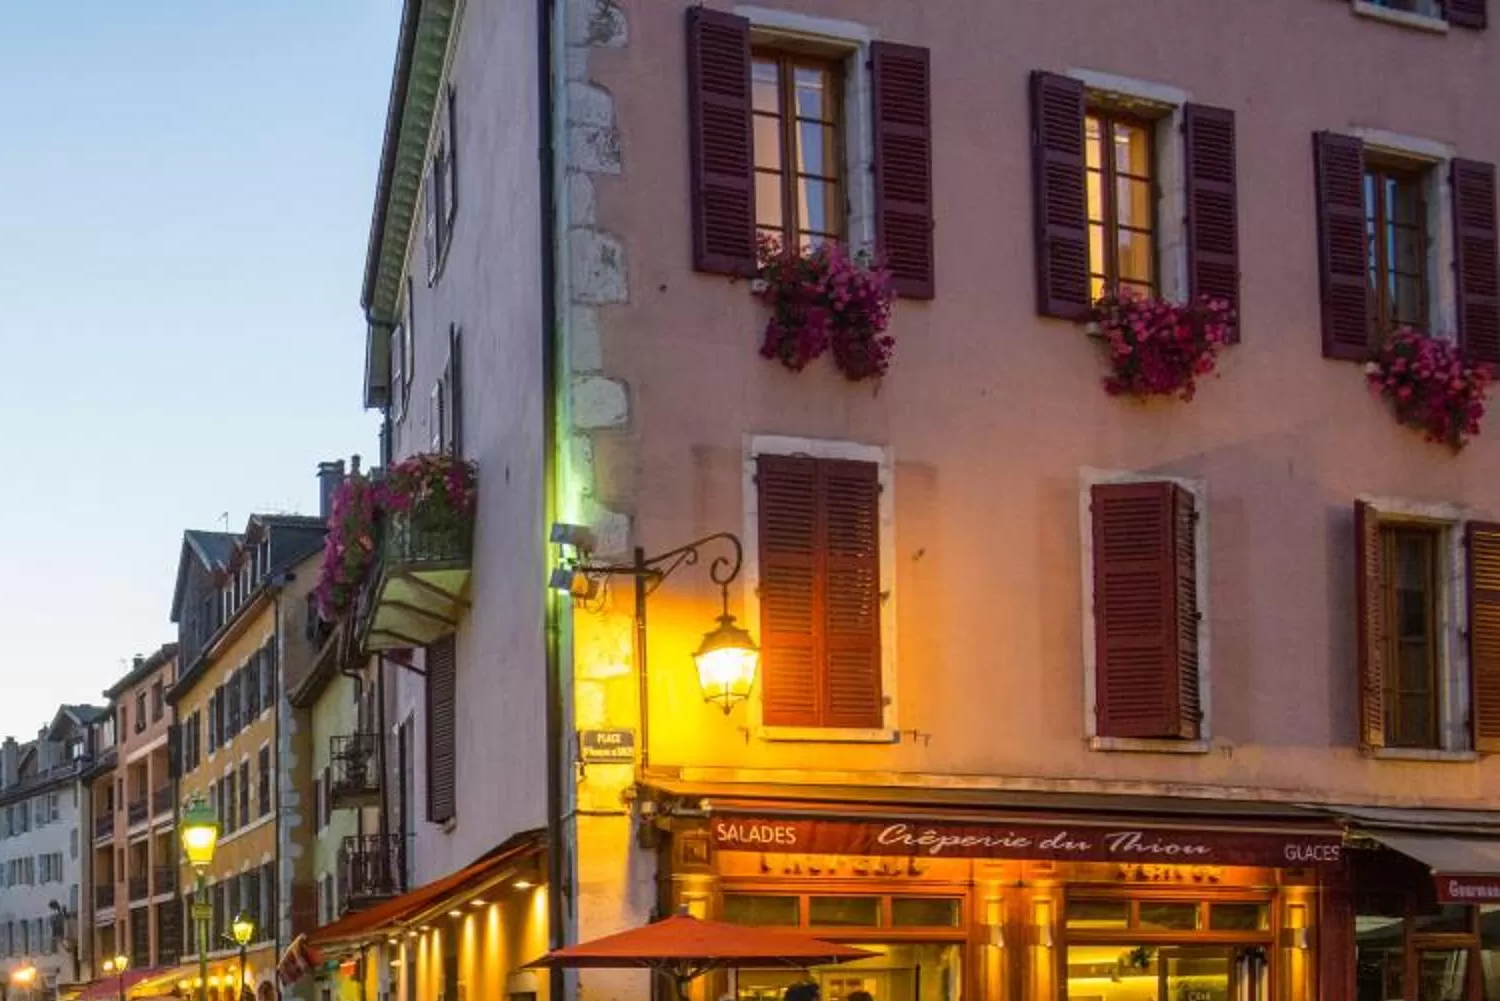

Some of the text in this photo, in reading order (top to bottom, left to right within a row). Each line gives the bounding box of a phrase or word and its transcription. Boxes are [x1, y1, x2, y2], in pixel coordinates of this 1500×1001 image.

[716, 823, 797, 845] SALADES
[877, 823, 1212, 856] Crêperie du Thiou
[1284, 844, 1340, 861] GLACES
